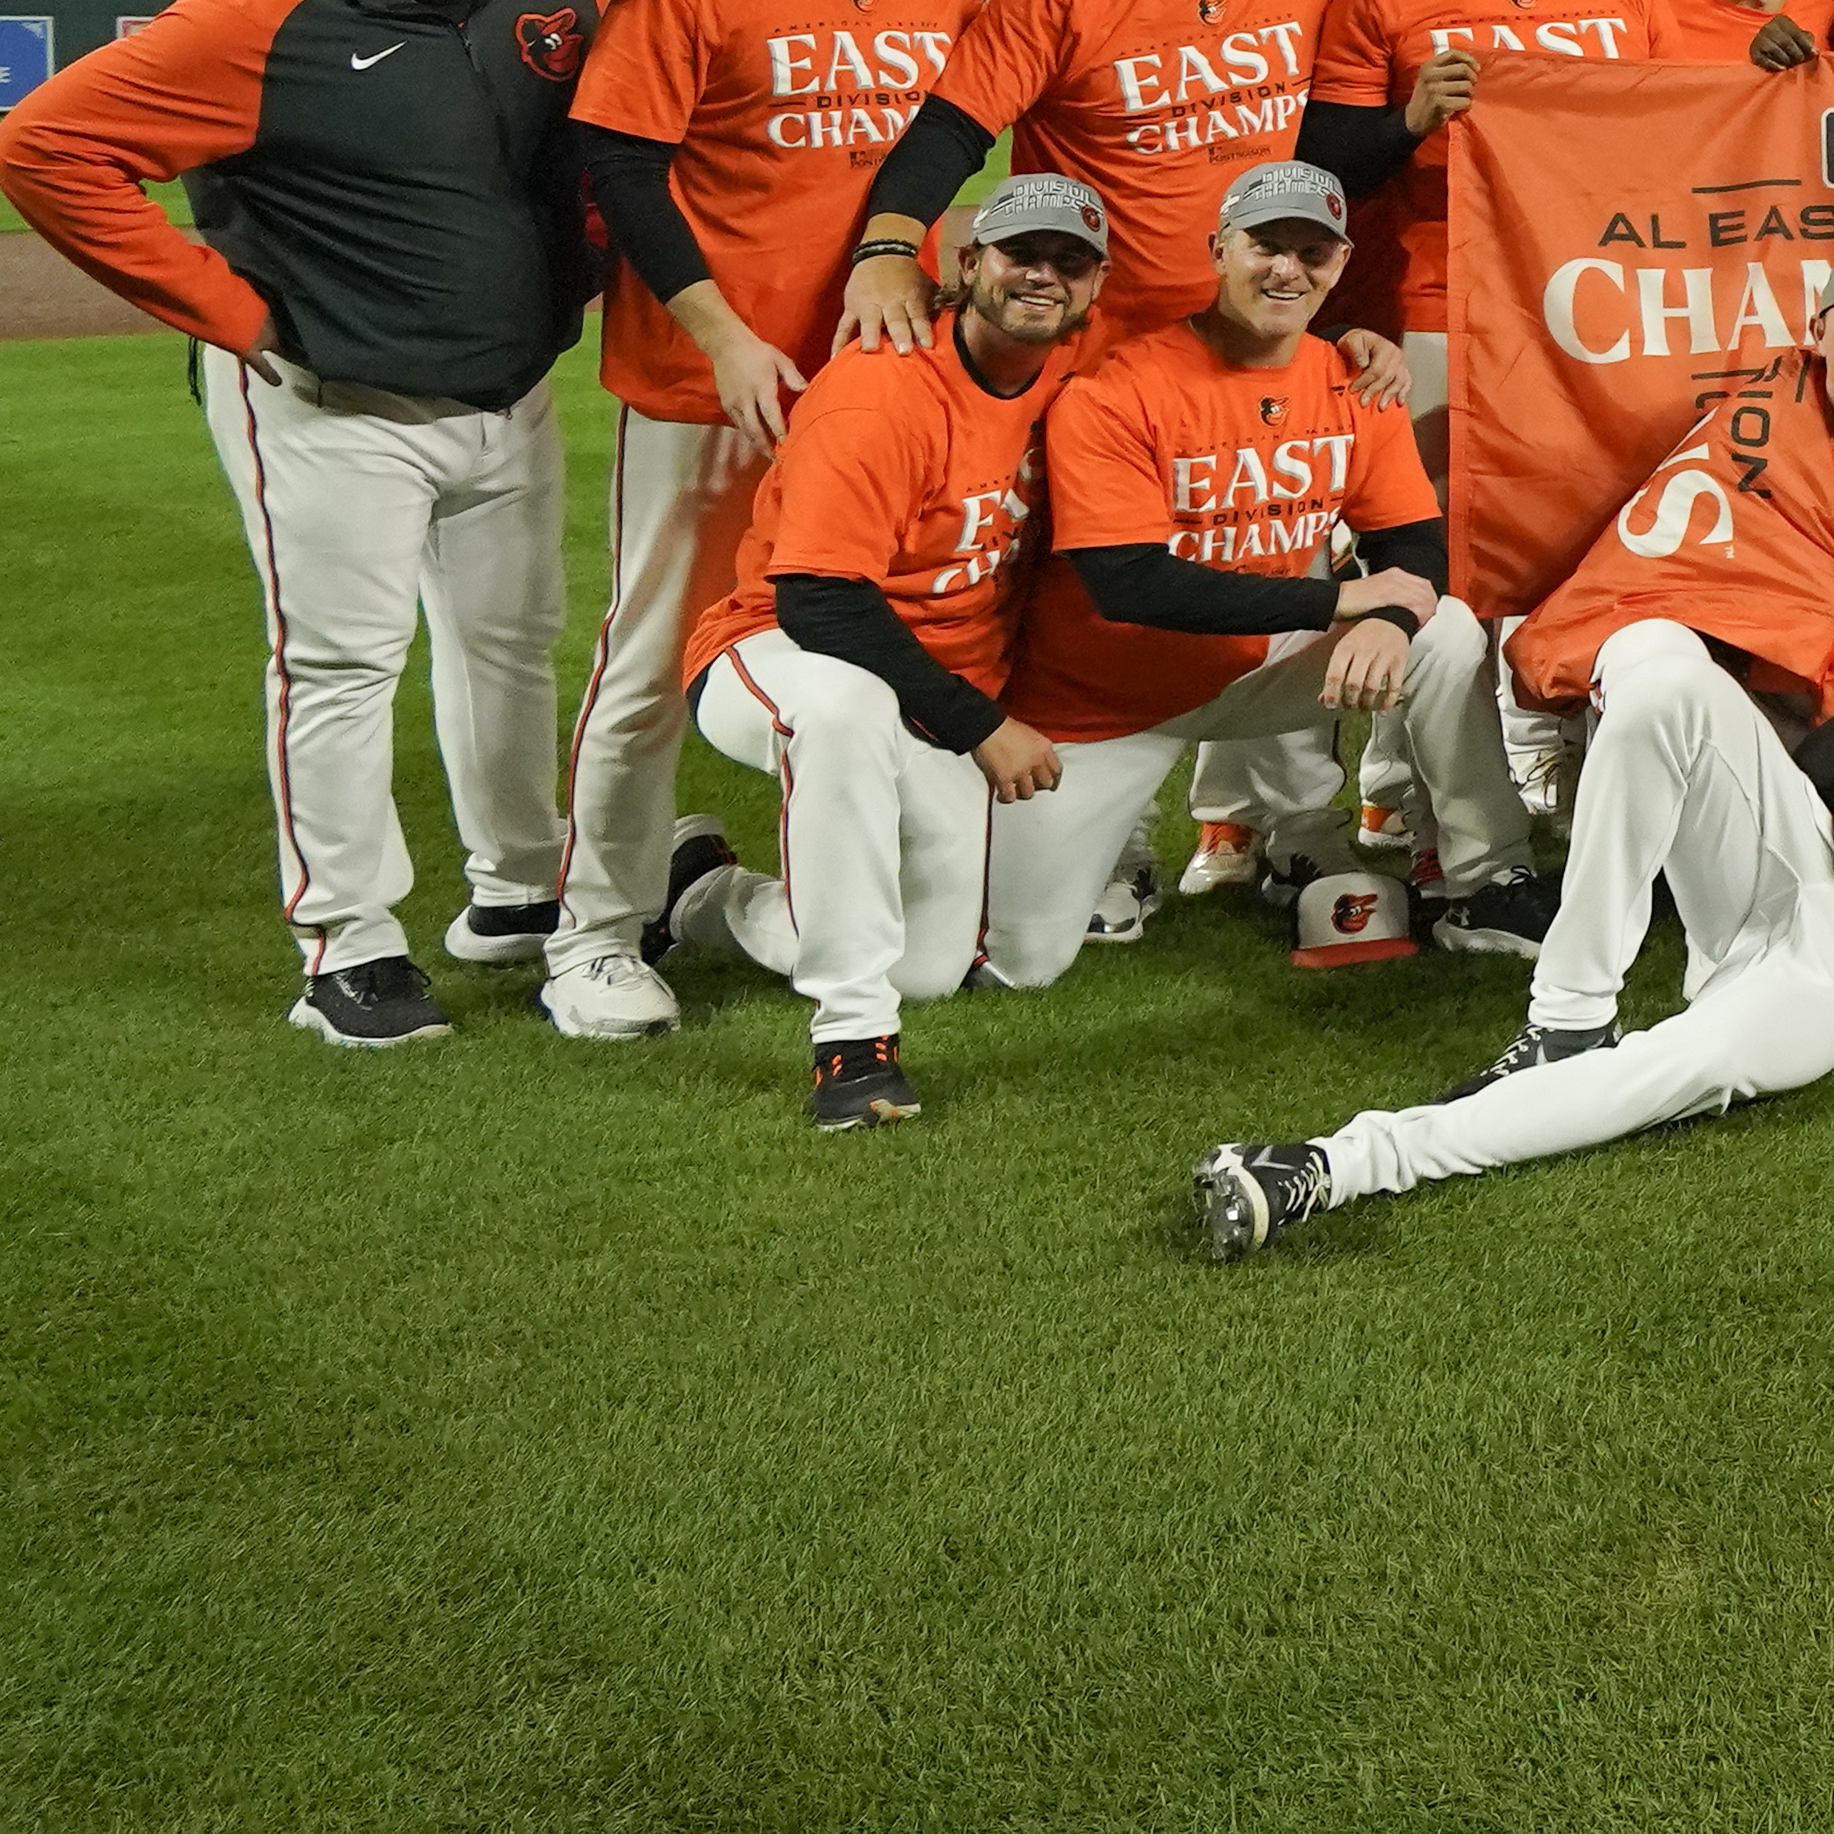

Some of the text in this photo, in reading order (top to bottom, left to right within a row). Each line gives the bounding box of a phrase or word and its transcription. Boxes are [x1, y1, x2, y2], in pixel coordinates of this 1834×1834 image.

[767, 30, 952, 98] EAST
[1114, 21, 1303, 113] EAST
[817, 86, 929, 109] DIVISIO
[1173, 83, 1285, 120] DIVISION
[768, 107, 921, 149] CHAM
[1598, 212, 1687, 250] AL
[1172, 433, 1357, 513] EAST
[1212, 497, 1325, 527] DIVISION
[1167, 505, 1341, 565] CHAMPS
